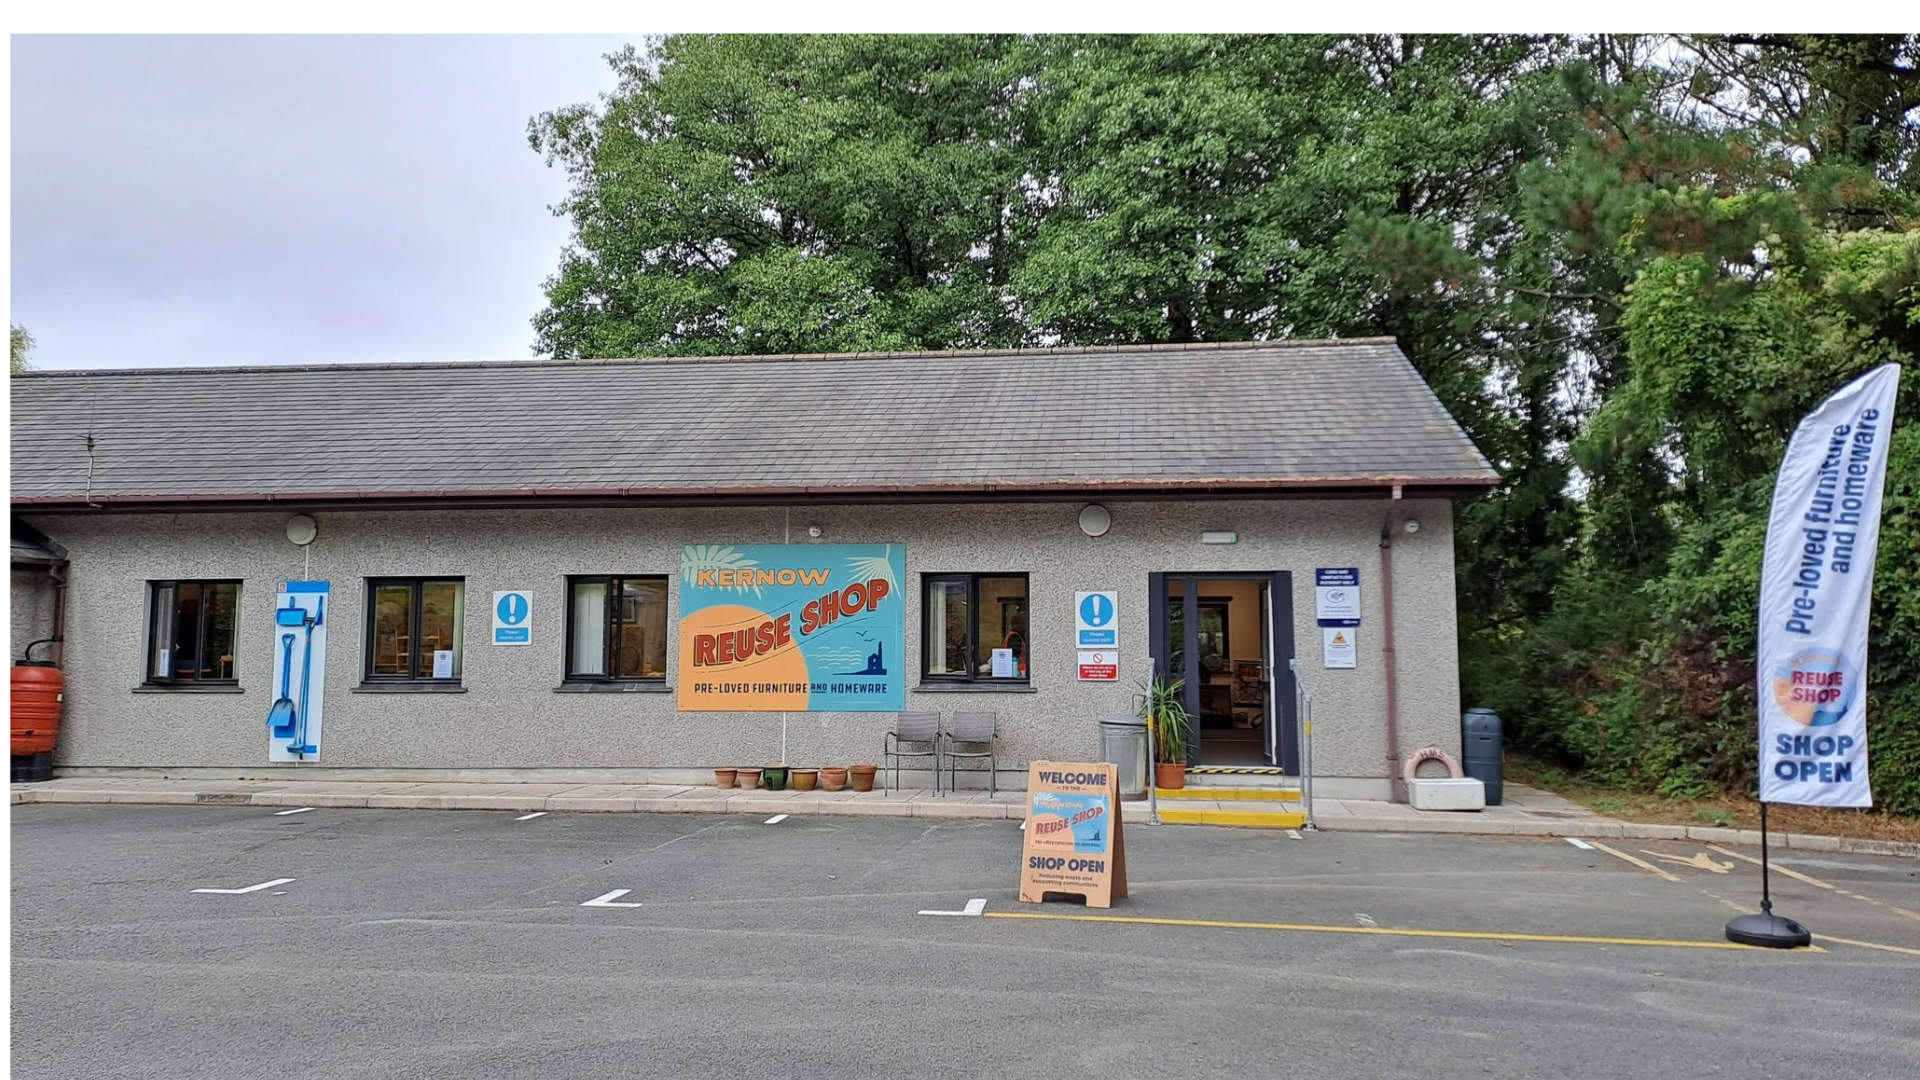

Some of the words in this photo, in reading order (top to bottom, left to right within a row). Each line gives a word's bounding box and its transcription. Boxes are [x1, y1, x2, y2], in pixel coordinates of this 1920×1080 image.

[1805, 423, 1851, 523] furniture
[1834, 407, 1880, 527] homeware
[1831, 532, 1856, 574] and
[697, 568, 831, 587] KERNOW
[1785, 527, 1828, 636] Pre-loved
[693, 613, 791, 667] REUSE
[800, 578, 889, 635] SHOP
[694, 683, 749, 694] PRE-LOVED
[752, 683, 808, 694] FURNITURE
[810, 683, 828, 693] AND
[830, 683, 887, 694] HOMEWARE
[1792, 671, 1843, 686] REUSE
[1793, 688, 1841, 703] SHOP
[1776, 733, 1853, 756] SHOP
[1038, 771, 1107, 786] WELCOME
[1775, 760, 1853, 783] OPEN
[1035, 818, 1070, 834] REUSE
[1072, 806, 1103, 825] SHOP
[1029, 856, 1065, 870] SHOP
[1068, 859, 1105, 873] OPEN
